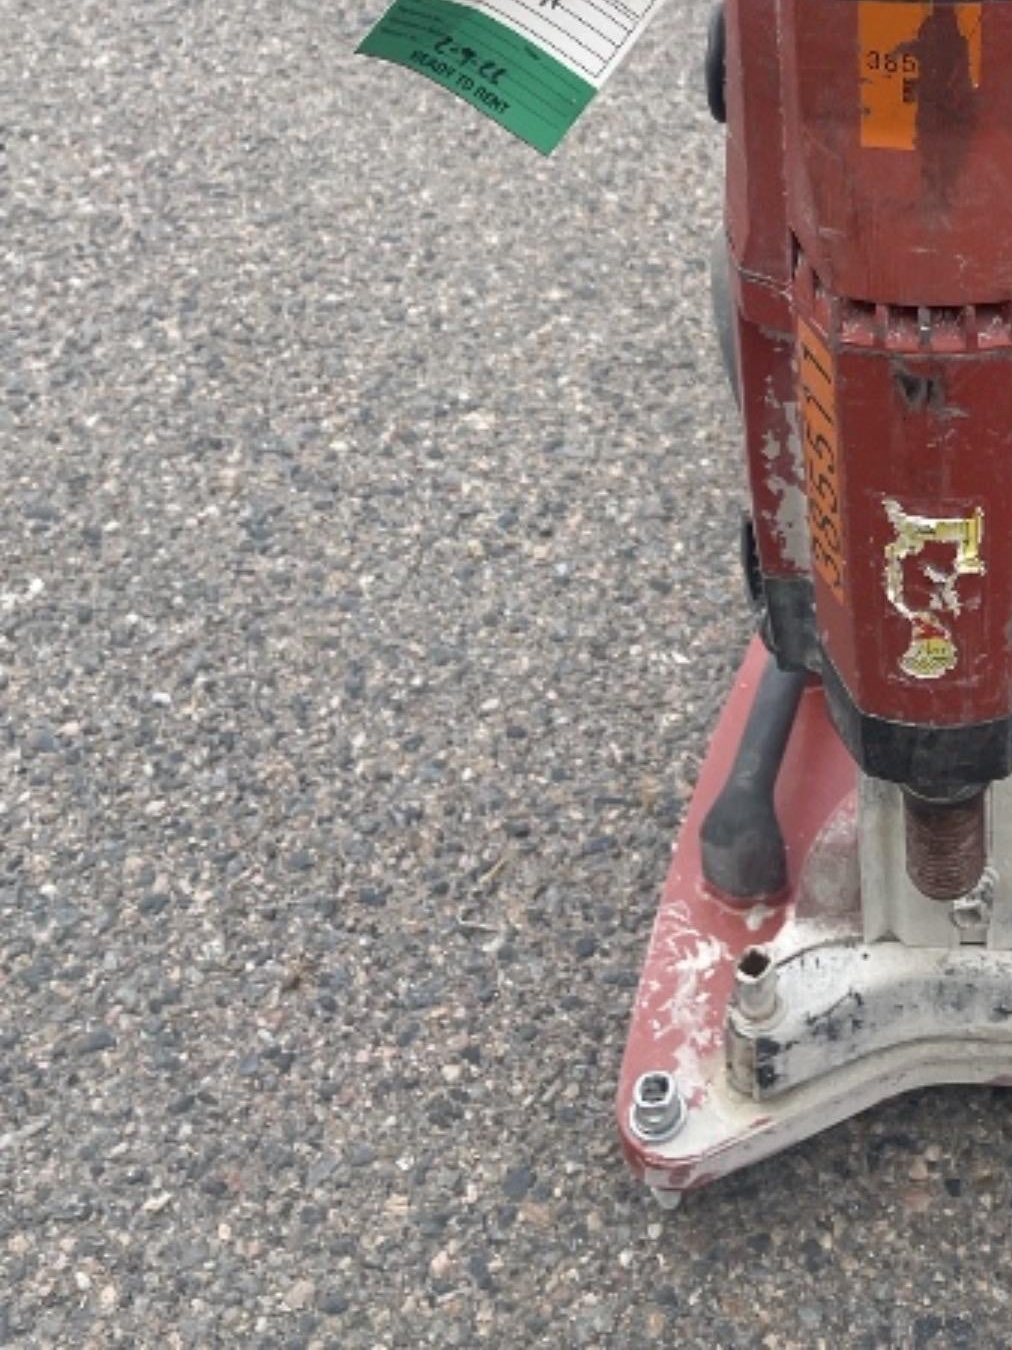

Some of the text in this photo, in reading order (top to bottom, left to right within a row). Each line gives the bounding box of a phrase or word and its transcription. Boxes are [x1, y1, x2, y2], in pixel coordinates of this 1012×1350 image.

[410, 50, 511, 114] READY TO RENT
